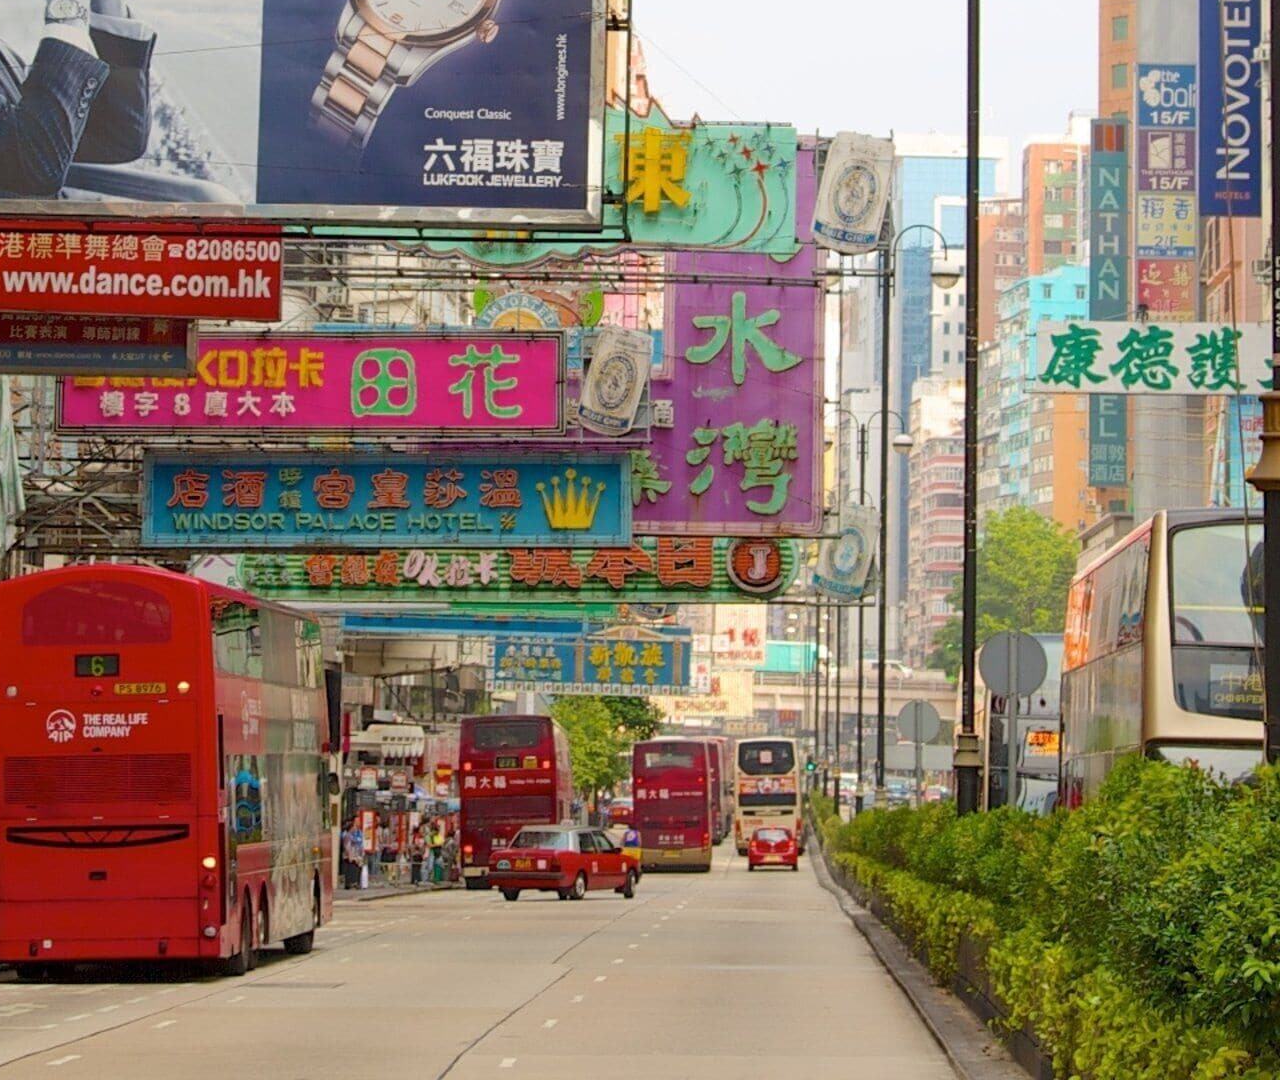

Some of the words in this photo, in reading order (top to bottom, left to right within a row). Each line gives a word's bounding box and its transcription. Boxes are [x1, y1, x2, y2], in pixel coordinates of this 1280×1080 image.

[556, 33, 568, 121] www.longines.hk
[425, 108, 474, 121] Conquest
[477, 109, 512, 121] Classic
[1150, 111, 1190, 126] 15/F
[423, 138, 565, 173] 六福珠寶
[423, 173, 484, 187] LUKFOOK
[486, 175, 562, 188] JEWELLERY
[1149, 176, 1189, 190] 15/F
[1098, 167, 1119, 300] NATHAN
[185, 239, 281, 264] 82086500
[3, 265, 271, 300] www.dance.com.hk
[173, 513, 285, 532] WINDSOR
[295, 513, 398, 532] PALACE
[408, 513, 495, 532] HOTEL
[91, 656, 104, 676] 6
[83, 713, 102, 725] THE
[103, 713, 127, 725] REAL
[128, 713, 148, 725] LIFE
[83, 726, 131, 738] COMPANY
